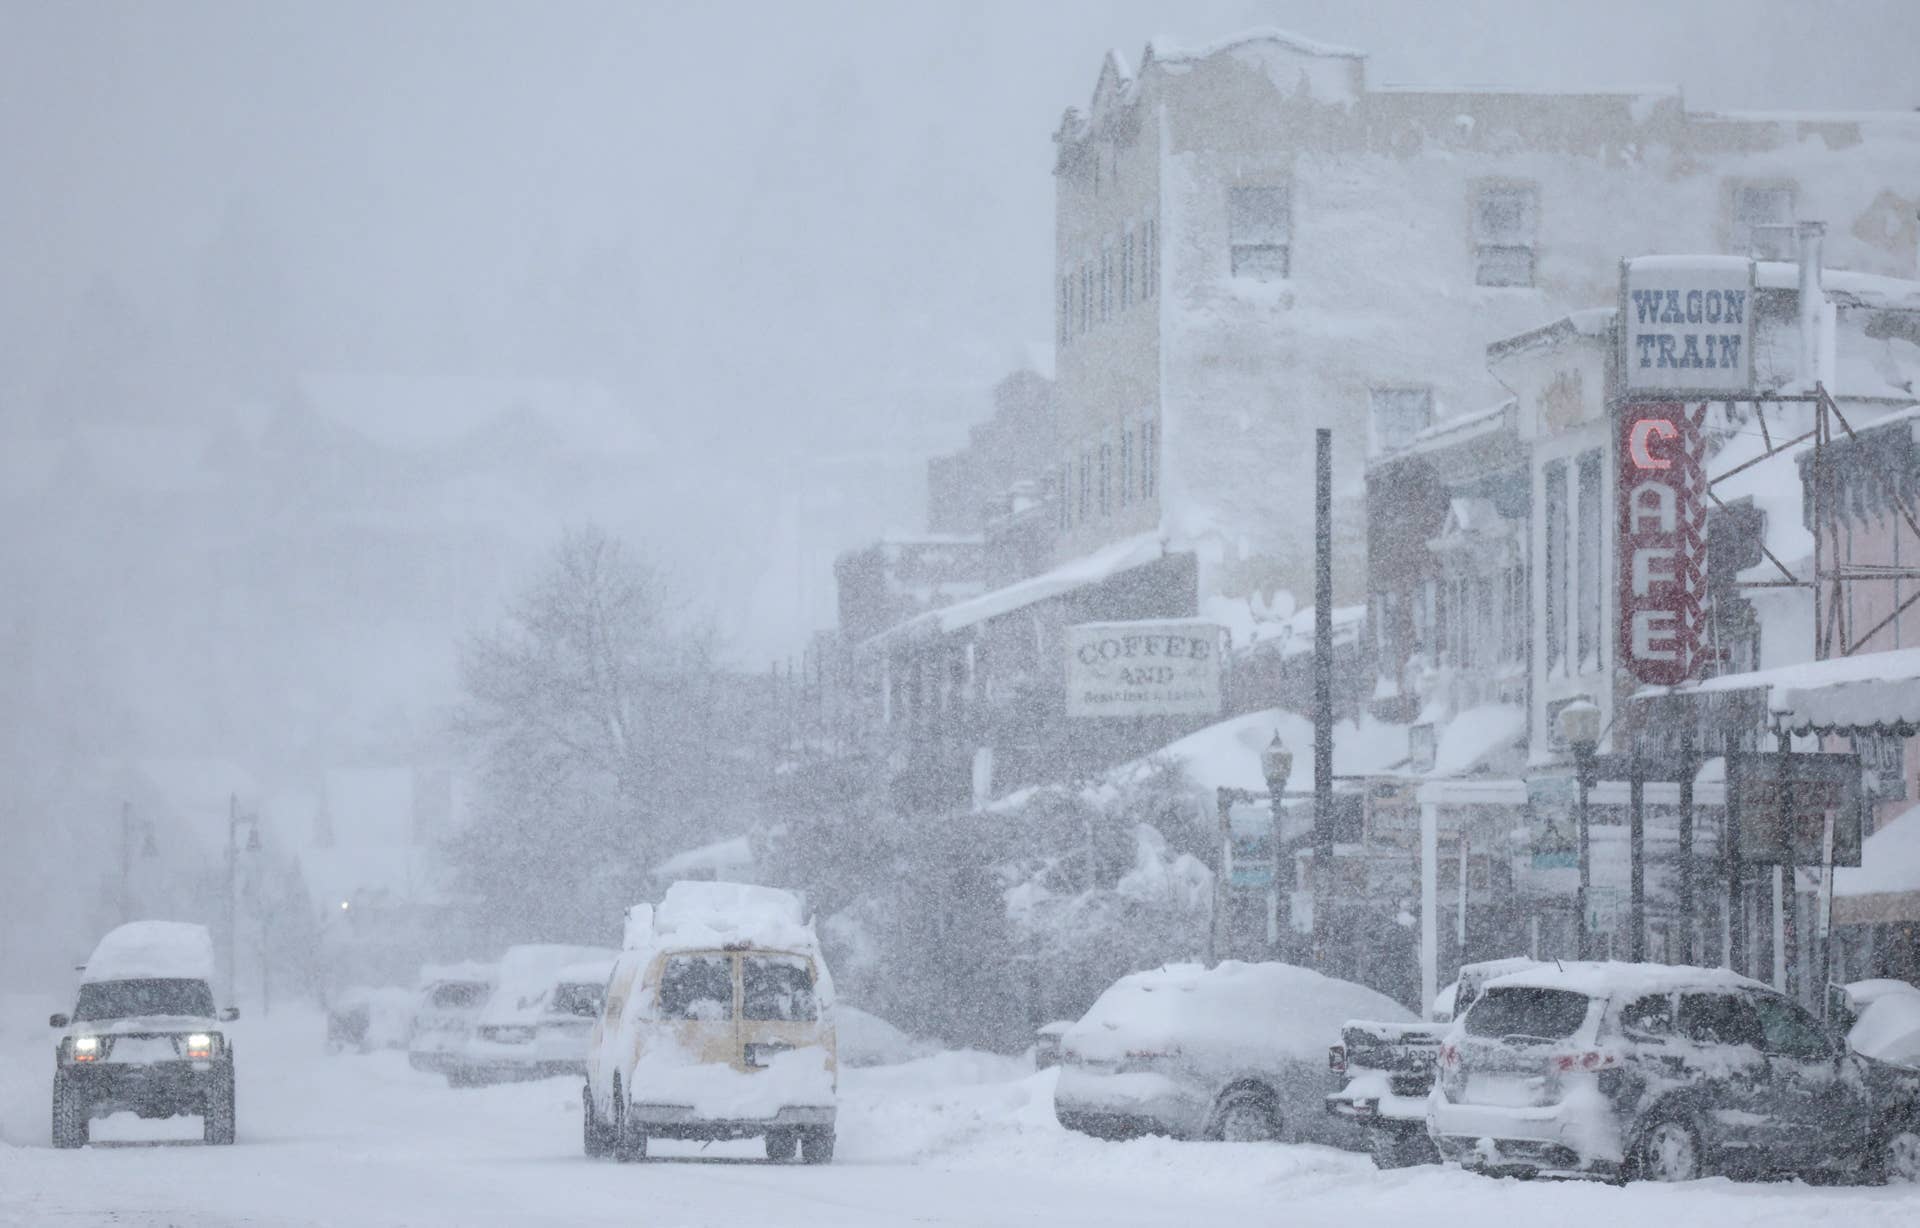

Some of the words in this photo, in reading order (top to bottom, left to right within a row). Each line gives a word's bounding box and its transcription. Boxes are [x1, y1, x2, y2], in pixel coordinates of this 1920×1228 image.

[1632, 289, 1746, 324] WAGON
[1636, 334, 1741, 369] TRAIN
[1630, 420, 1679, 660] CAFE
[1078, 635, 1210, 665] COFFEE
[1120, 667, 1174, 685] AND
